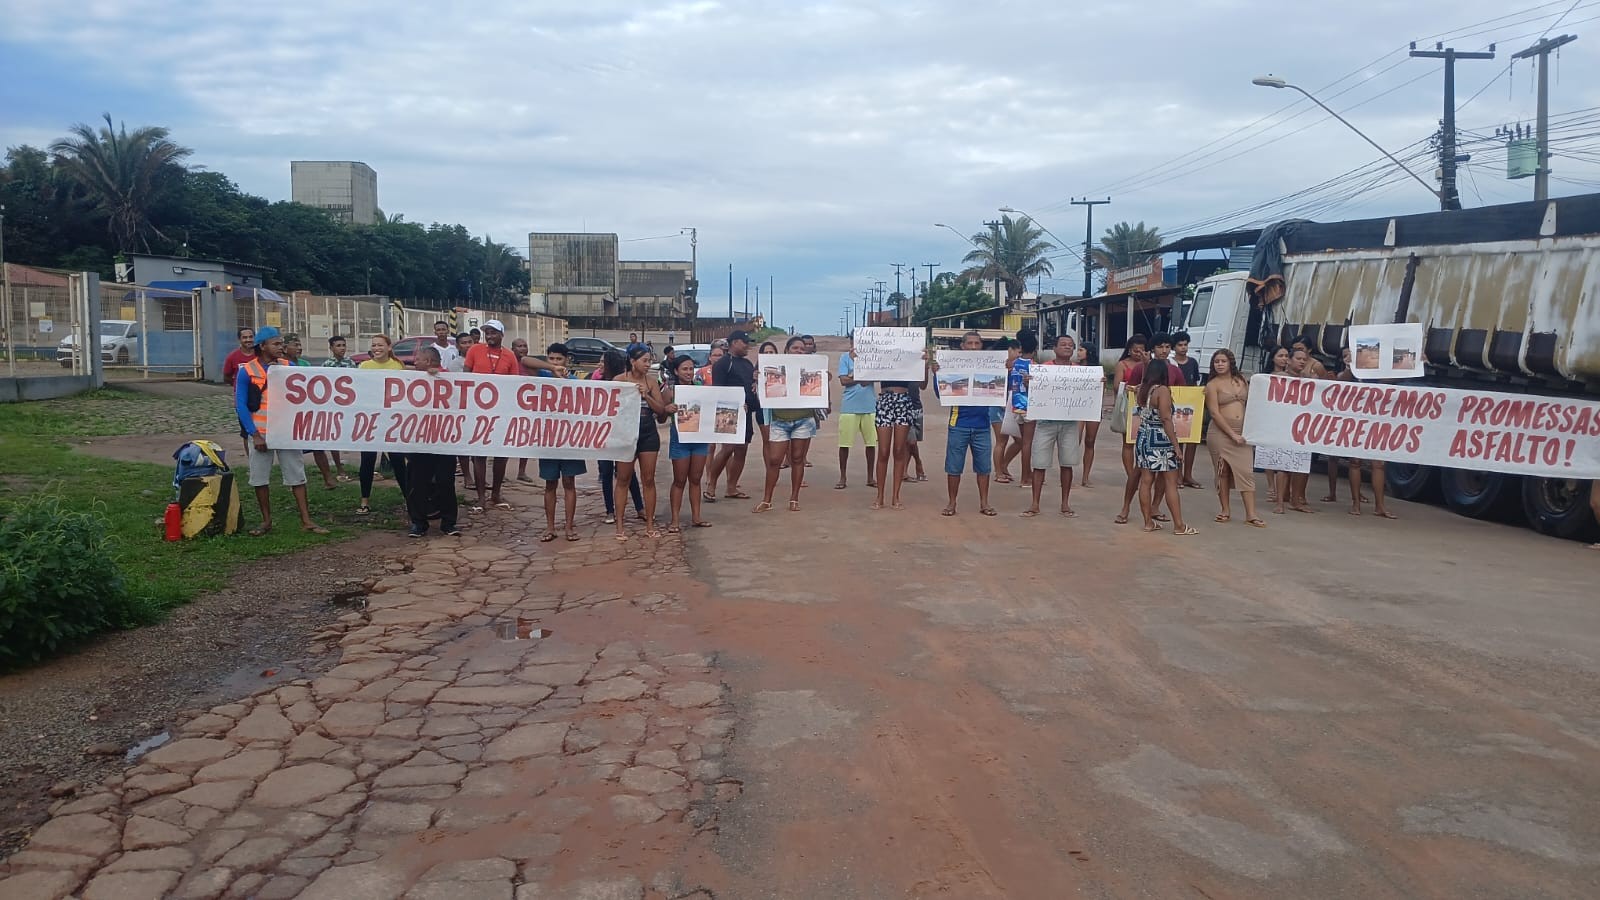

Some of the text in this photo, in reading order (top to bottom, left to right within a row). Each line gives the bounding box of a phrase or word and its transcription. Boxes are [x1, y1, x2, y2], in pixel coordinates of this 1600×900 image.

[285, 374, 622, 418] SOS PORTO GRANDE
[1321, 383, 1447, 420] QUEREMOS
[292, 411, 345, 441] MAIS
[351, 412, 381, 443] DE
[469, 414, 501, 446] DE
[1290, 412, 1577, 467] QUEREMOS ASFALTO!
